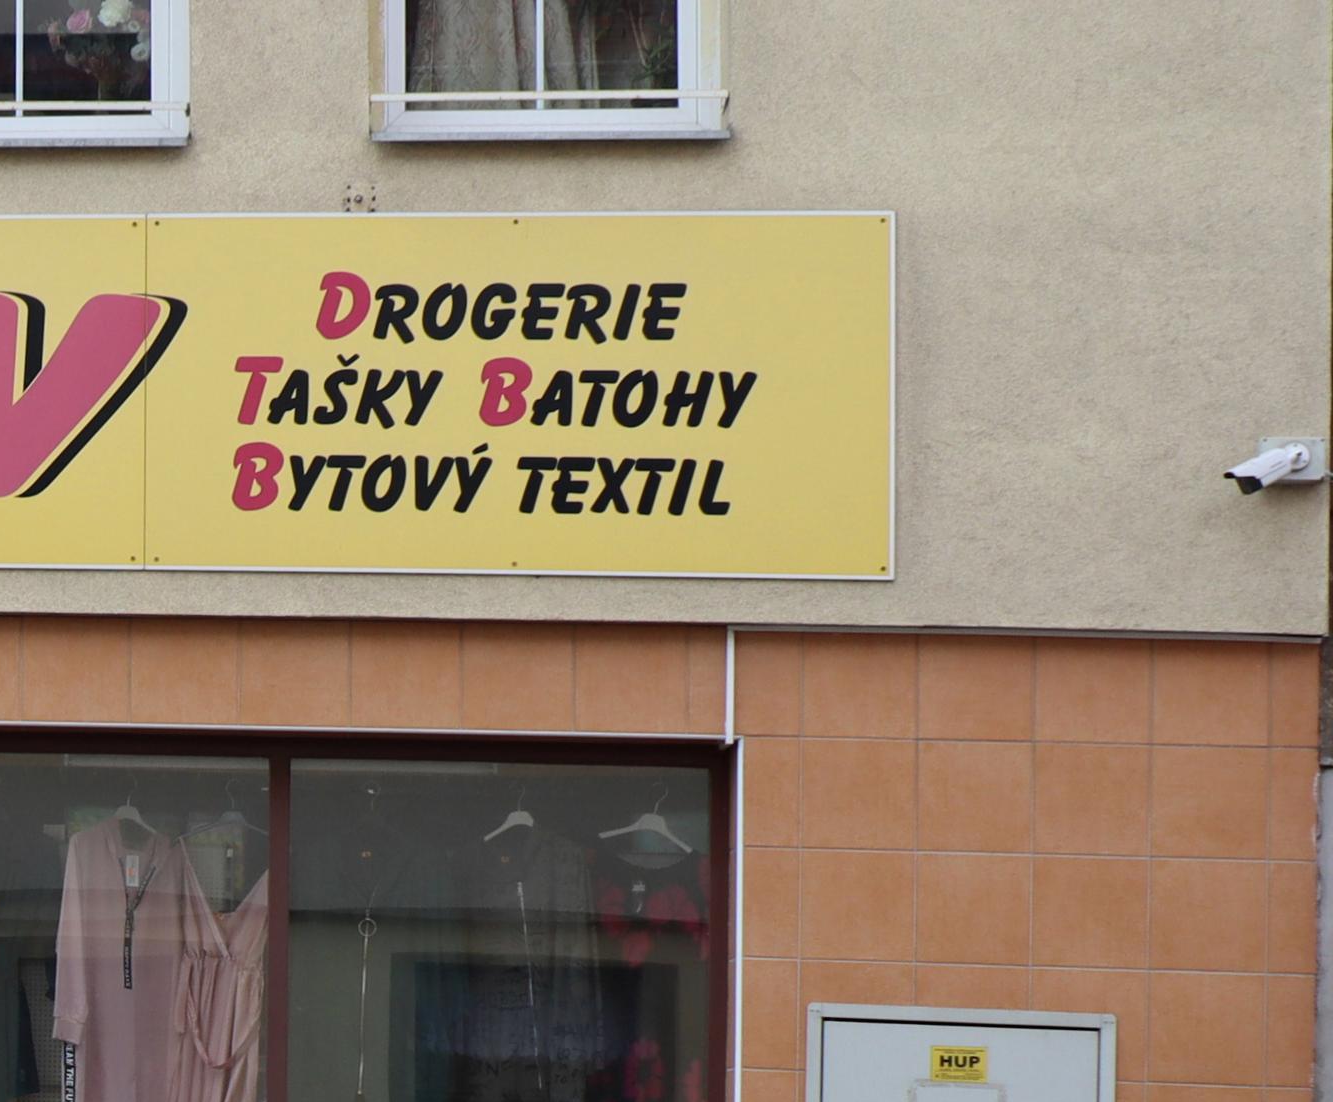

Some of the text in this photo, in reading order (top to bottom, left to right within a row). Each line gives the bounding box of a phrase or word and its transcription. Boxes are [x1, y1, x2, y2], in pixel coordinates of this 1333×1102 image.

[315, 271, 688, 344] DROGERIE
[234, 353, 757, 429] TAŠKY BATOHY
[233, 442, 731, 516] BYTOVÝ TEXTIL
[939, 1055, 981, 1069] HUP
